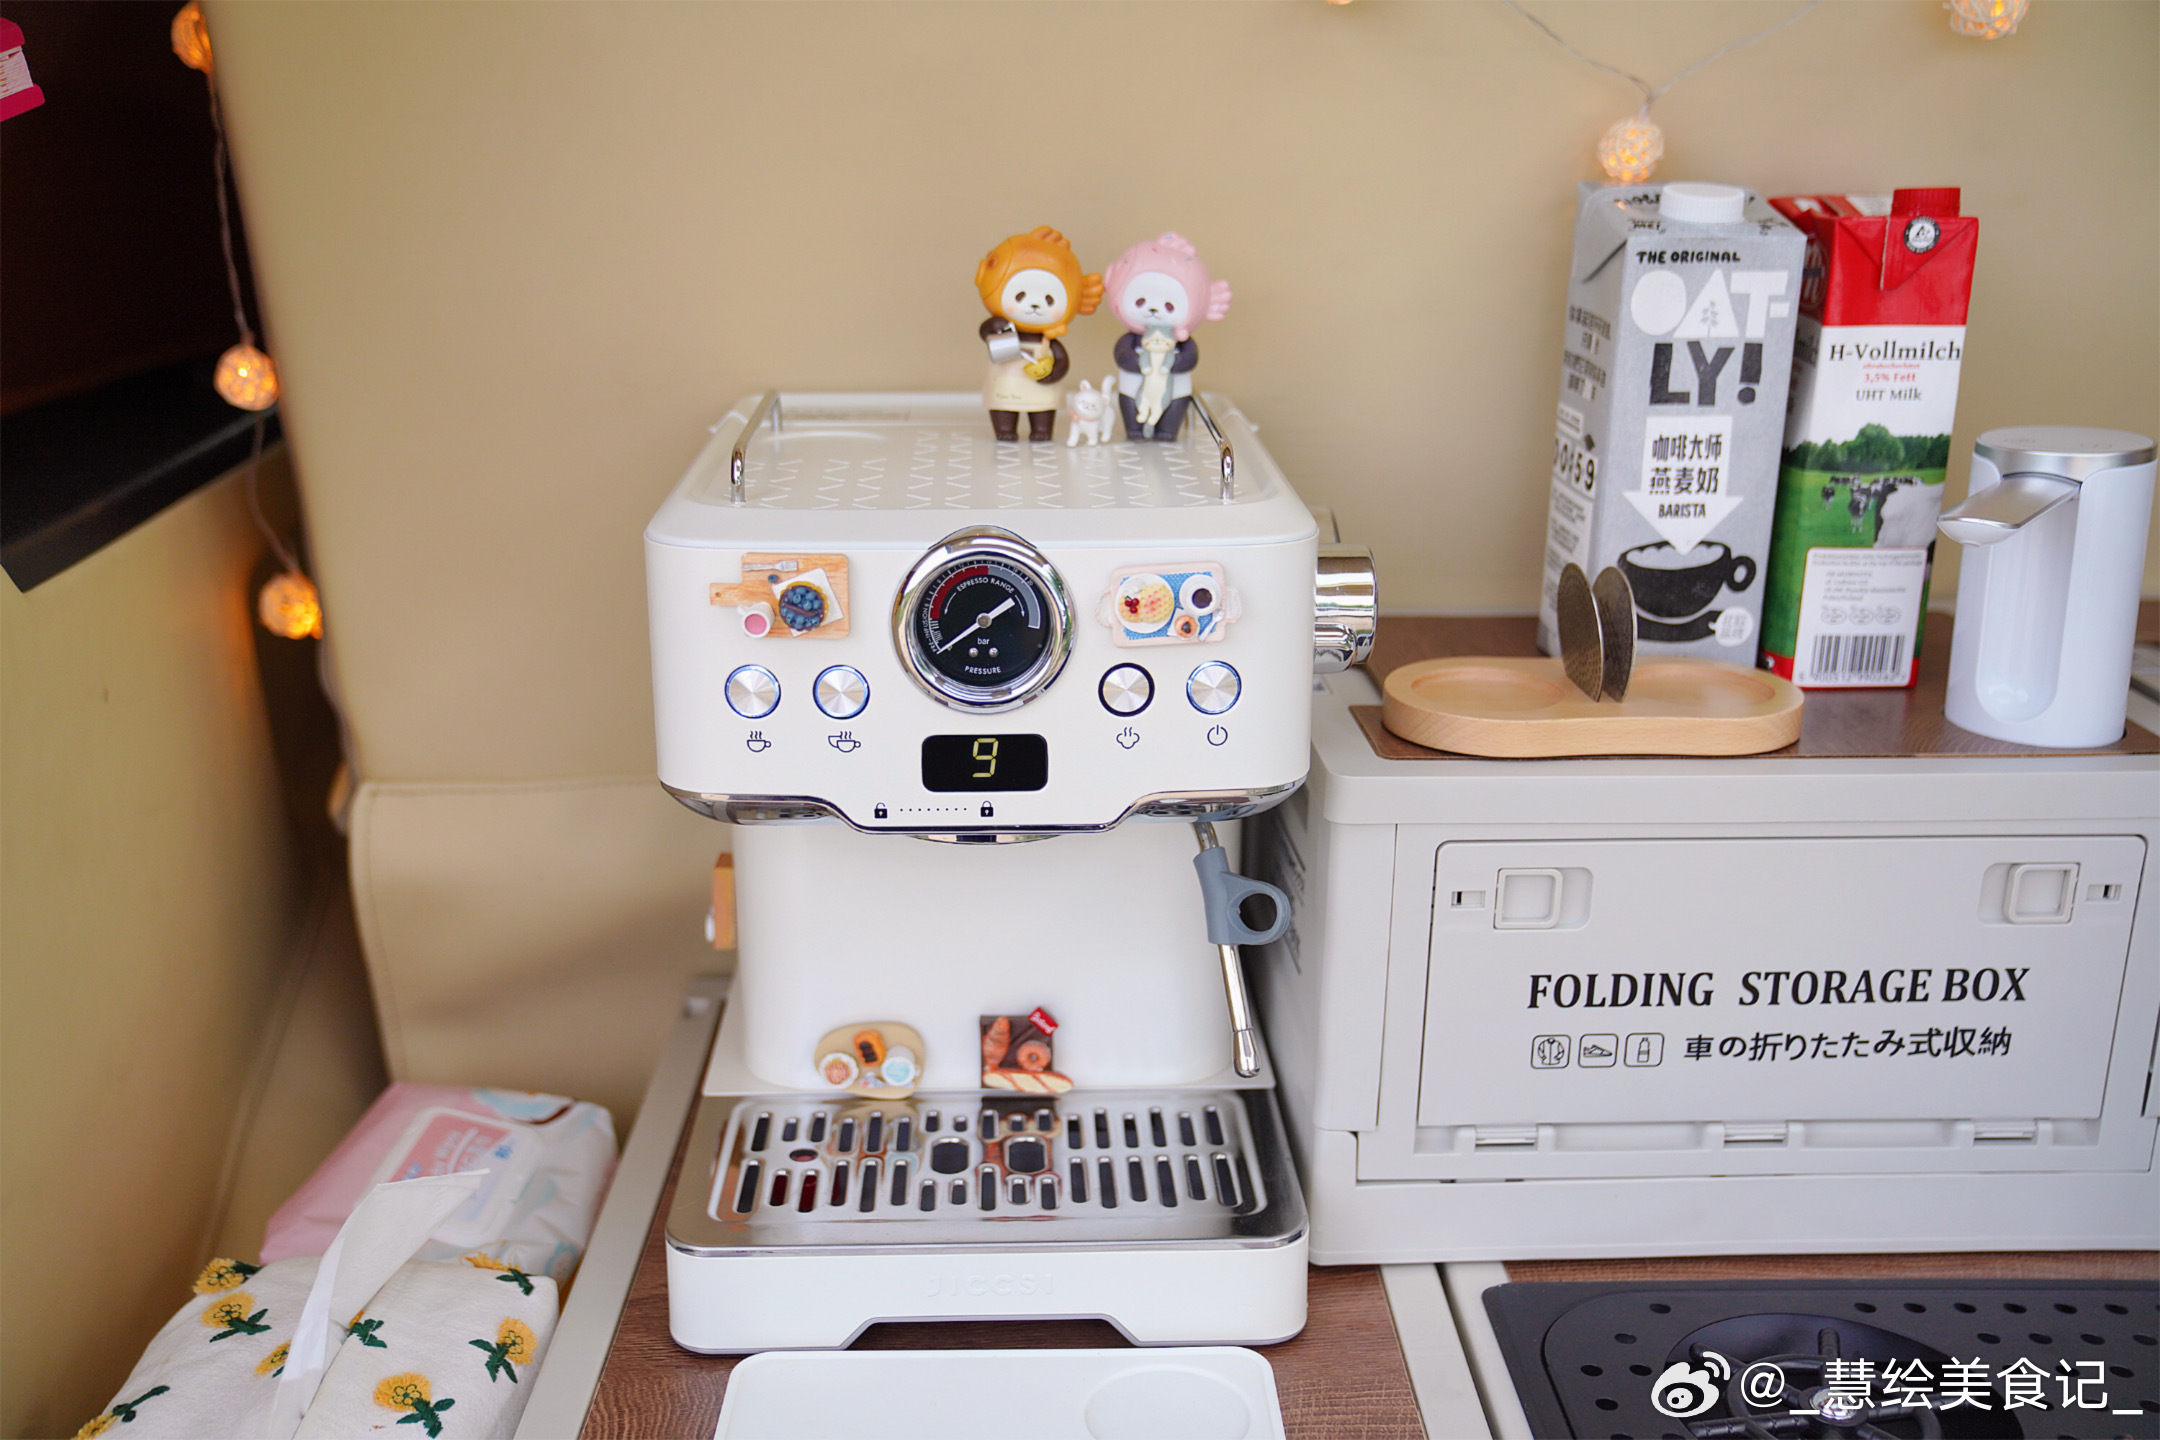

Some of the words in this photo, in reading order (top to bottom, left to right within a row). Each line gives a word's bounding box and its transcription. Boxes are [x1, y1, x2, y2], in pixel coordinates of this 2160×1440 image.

[1636, 250, 1667, 265] THE
[1670, 250, 1741, 265] ORIGINAL
[1829, 340, 1961, 361] H-Vollmilch
[1649, 340, 1764, 408] LY!
[1893, 373, 1916, 383] Fett
[1856, 389, 1885, 401] UHT
[1889, 388, 1922, 401] Milk
[1652, 433, 1723, 463] 咖啡大师
[1649, 466, 1720, 496] 燕麦奶
[1658, 503, 1706, 519] BARISTA
[957, 577, 989, 592] ESPRESSO
[990, 578, 1014, 594] RANGE
[977, 637, 990, 646] bar
[964, 665, 1002, 676] PRESSURE
[972, 737, 999, 778] 9
[1527, 972, 1714, 1009] FOLDING
[1738, 968, 1932, 1006] STORAGE
[1941, 967, 2030, 1002] BOX
[1683, 1025, 2013, 1062] 車の折りたたみ式収納
